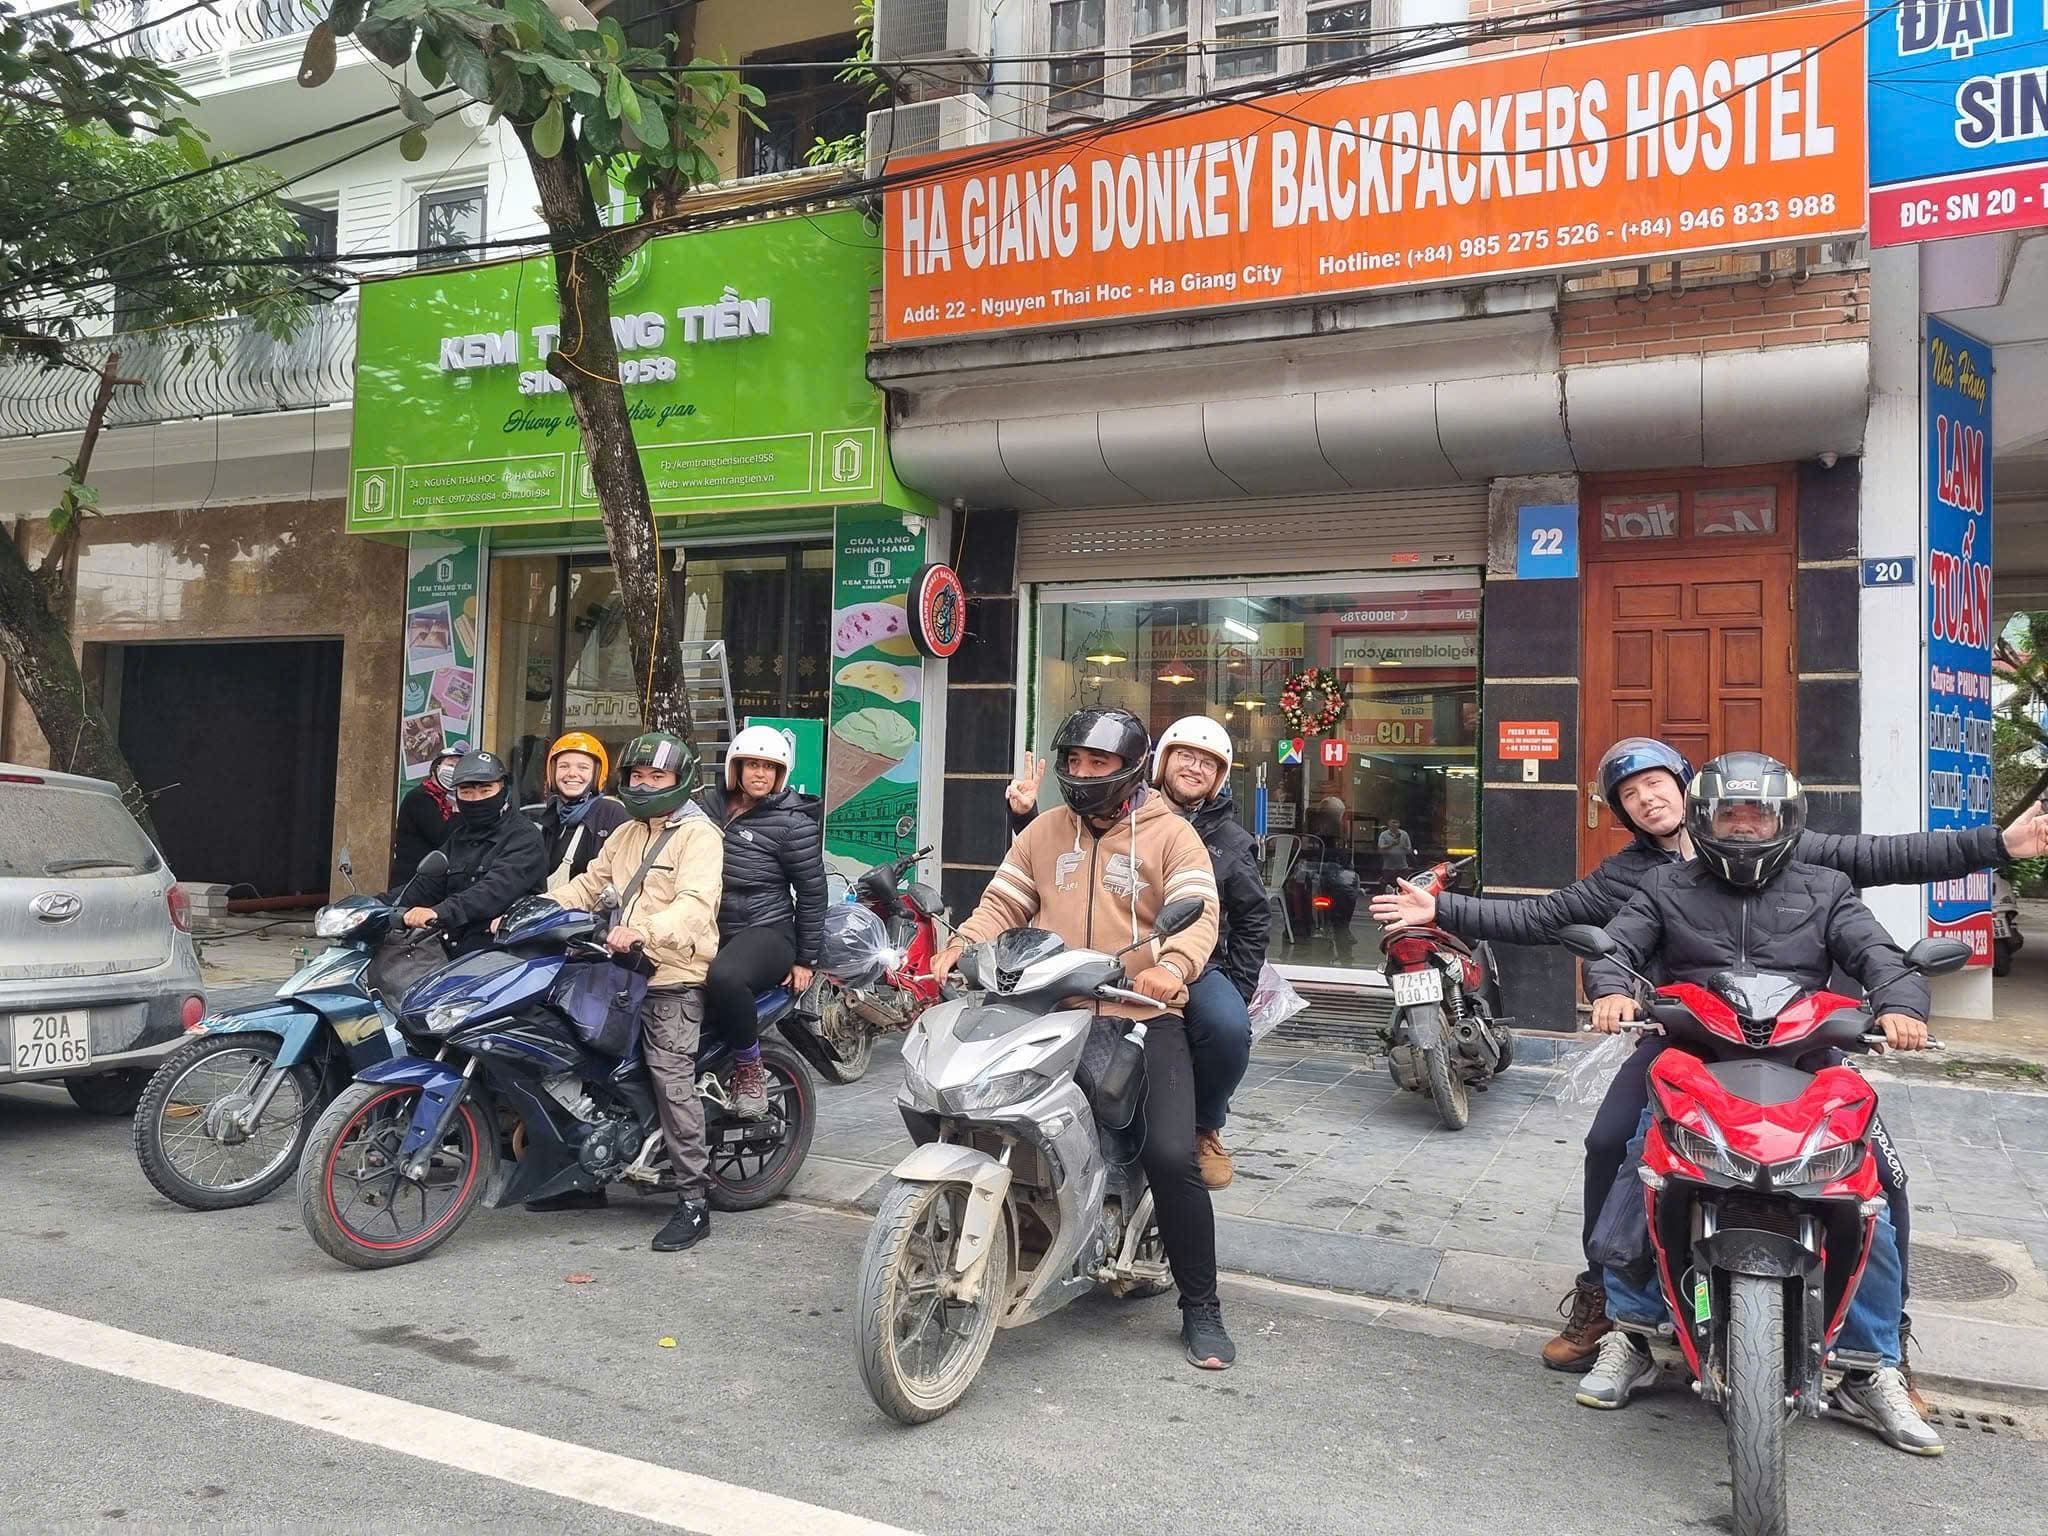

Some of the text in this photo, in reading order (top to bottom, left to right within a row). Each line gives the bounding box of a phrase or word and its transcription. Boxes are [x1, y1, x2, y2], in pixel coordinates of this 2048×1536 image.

[902, 185, 951, 277] HA
[961, 162, 1078, 270] GIANG
[1092, 135, 1259, 253] DONKEY
[1626, 47, 1836, 181] HOSTEL
[1899, 199, 1939, 228] ĐC:
[1945, 192, 1979, 221] SN
[1985, 187, 2016, 217] 20
[1319, 250, 1401, 275] Hotline:
[1407, 244, 1453, 269] (+84)
[1460, 235, 1500, 258] 985
[1507, 230, 1550, 253] 275
[1556, 222, 1599, 246] 526
[1621, 217, 1672, 243] (+84)
[1679, 207, 1725, 232] 946
[1733, 199, 1780, 225] 833
[1788, 193, 1836, 219] 988
[903, 304, 940, 324] Add:
[944, 301, 966, 320] 22
[981, 295, 1046, 318] Nguyen
[1051, 287, 1090, 307] Thai
[1096, 283, 1132, 302] Hoc
[1149, 277, 1175, 295] Ha
[1181, 271, 1236, 291] Giang
[1242, 264, 1282, 286] City
[439, 284, 771, 371] KEM TNG TIỀN
[518, 370, 567, 395] SIN
[657, 400, 697, 427] gian
[1936, 414, 1984, 515] LAM
[1531, 528, 1564, 556] 22
[1875, 561, 1903, 583] 20
[1930, 518, 1990, 651] TUẤN
[1400, 971, 1433, 987] 72-F1
[1397, 985, 1440, 1003] 030.13
[32, 1015, 73, 1039] 20A
[18, 1040, 87, 1069] 270.65
